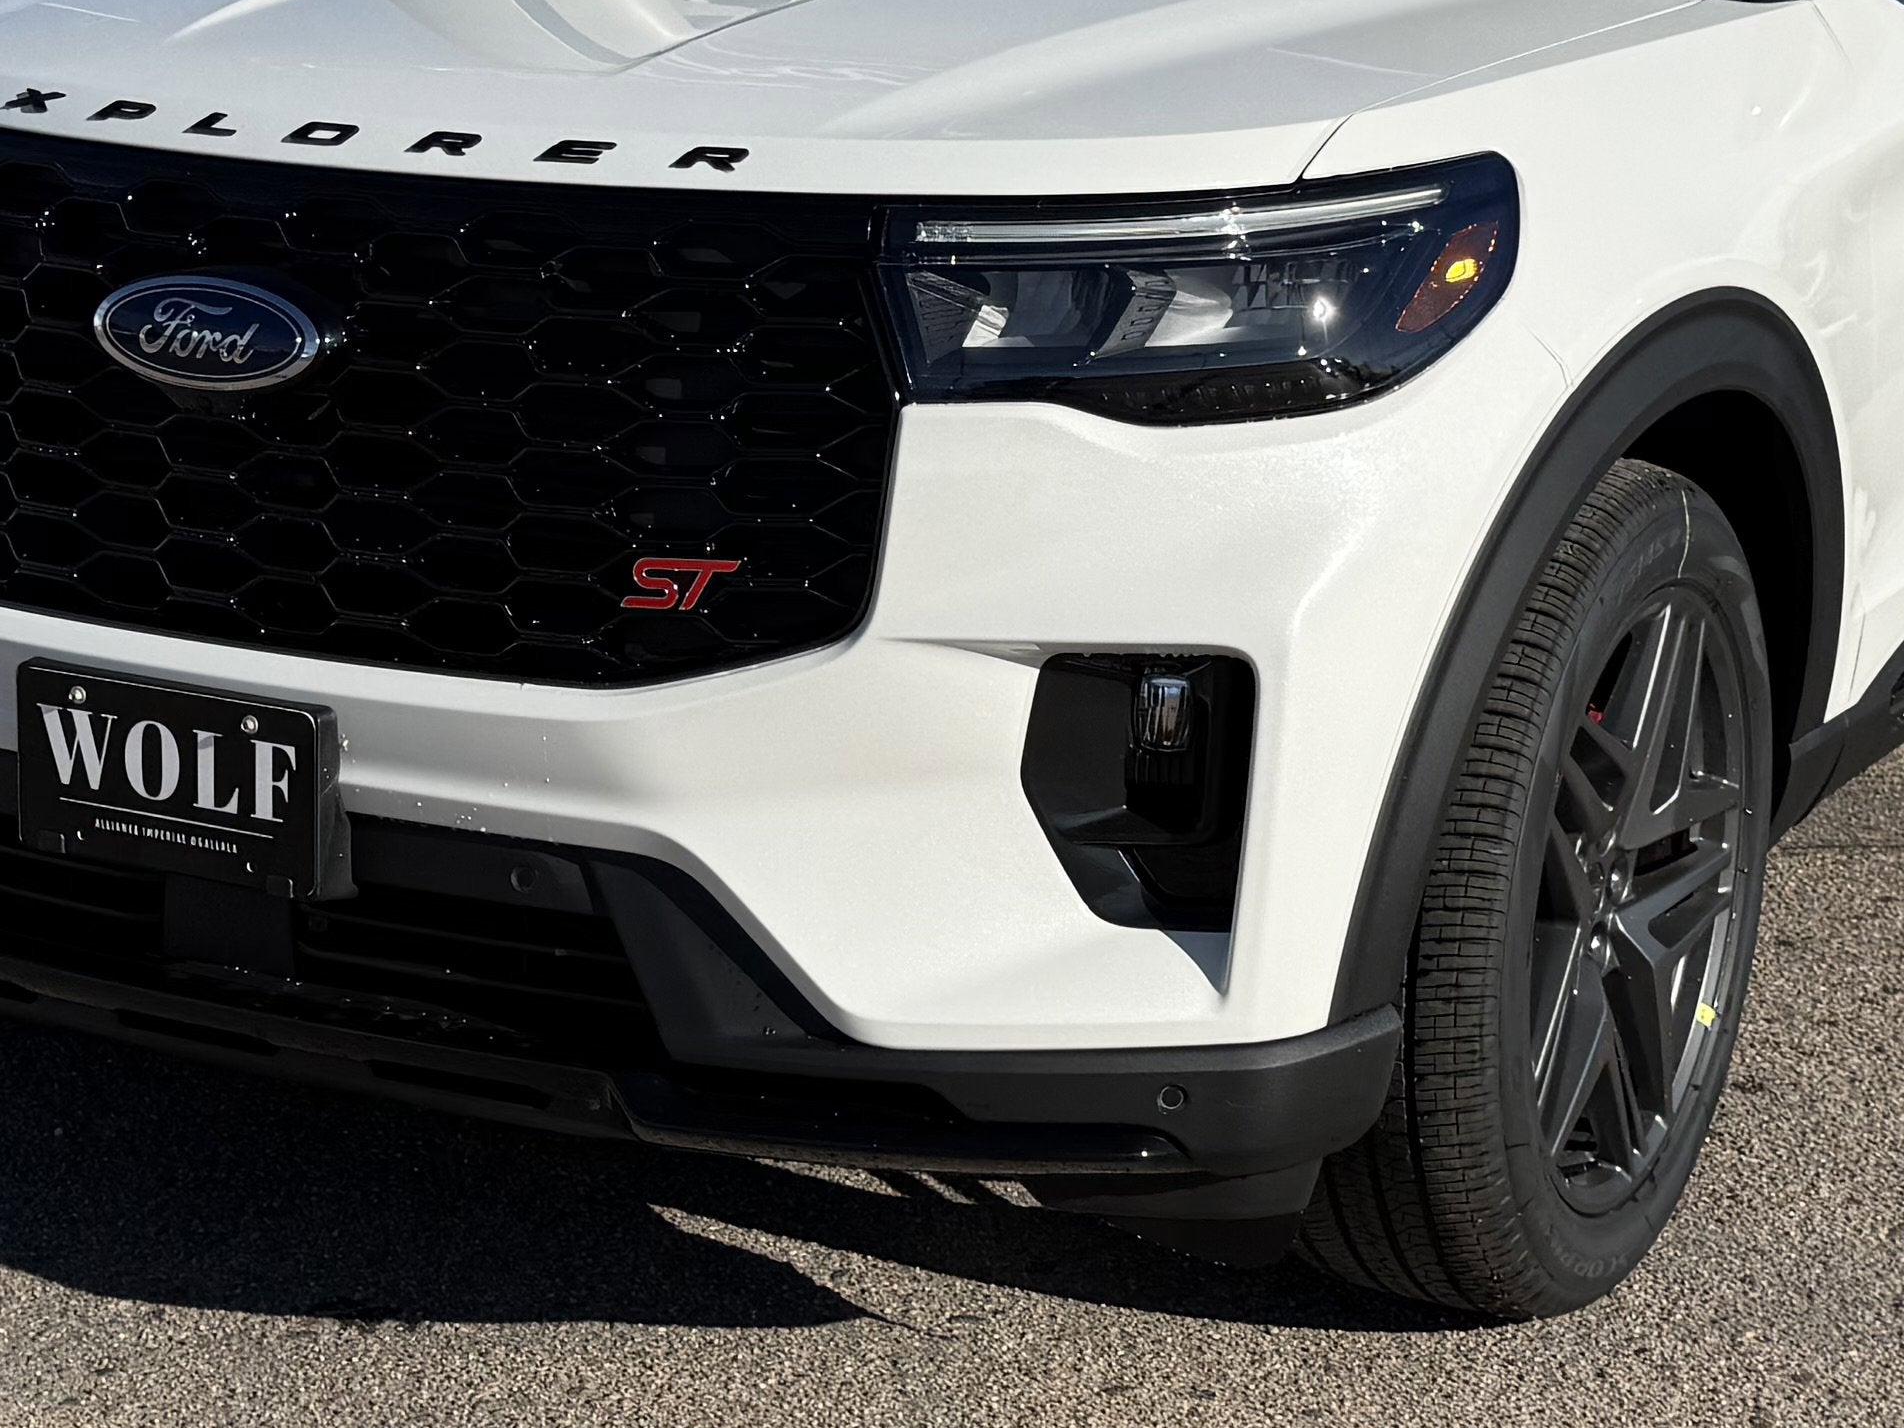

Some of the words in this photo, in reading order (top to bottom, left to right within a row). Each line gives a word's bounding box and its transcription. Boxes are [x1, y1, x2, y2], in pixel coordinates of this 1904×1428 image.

[139, 297, 260, 364] Ford
[620, 557, 742, 611] ST
[36, 703, 296, 823] WOLF
